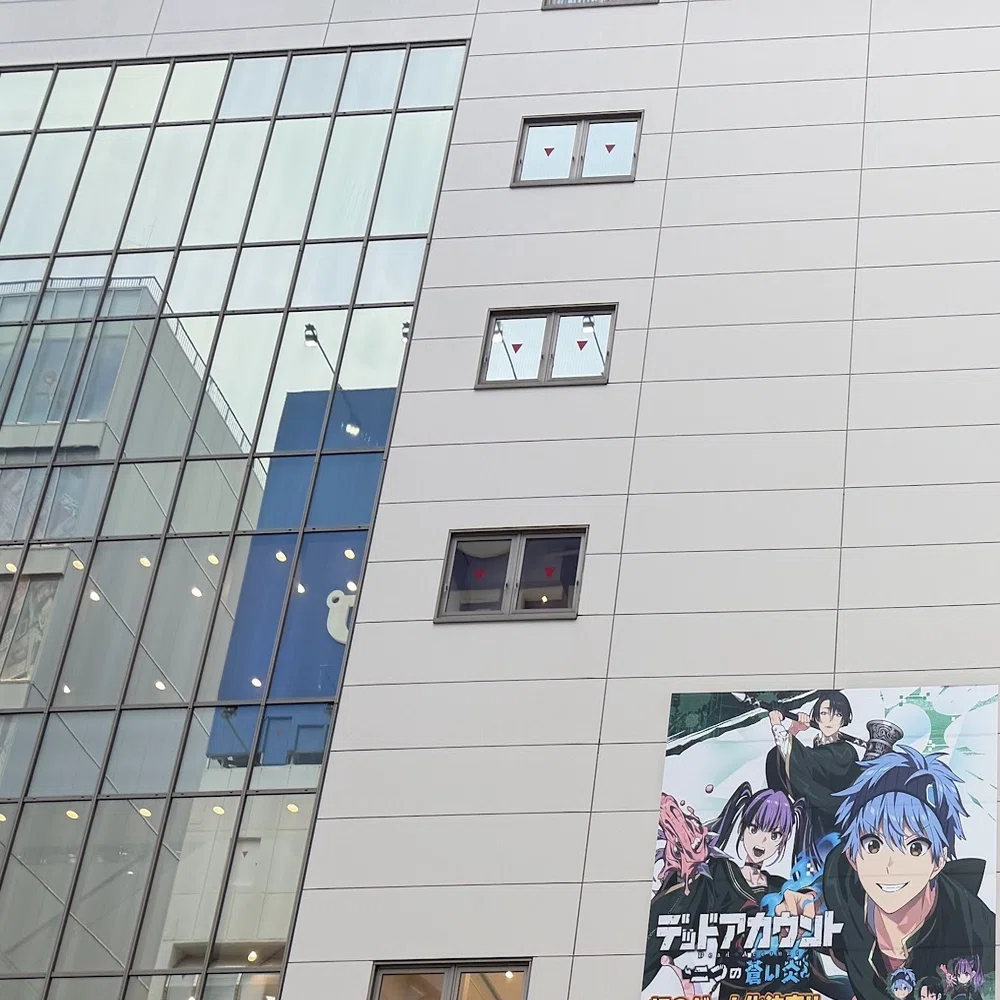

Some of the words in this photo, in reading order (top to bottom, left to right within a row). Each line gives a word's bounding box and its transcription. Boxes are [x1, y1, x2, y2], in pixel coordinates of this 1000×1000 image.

[656, 911, 844, 950] デッドアカウント
